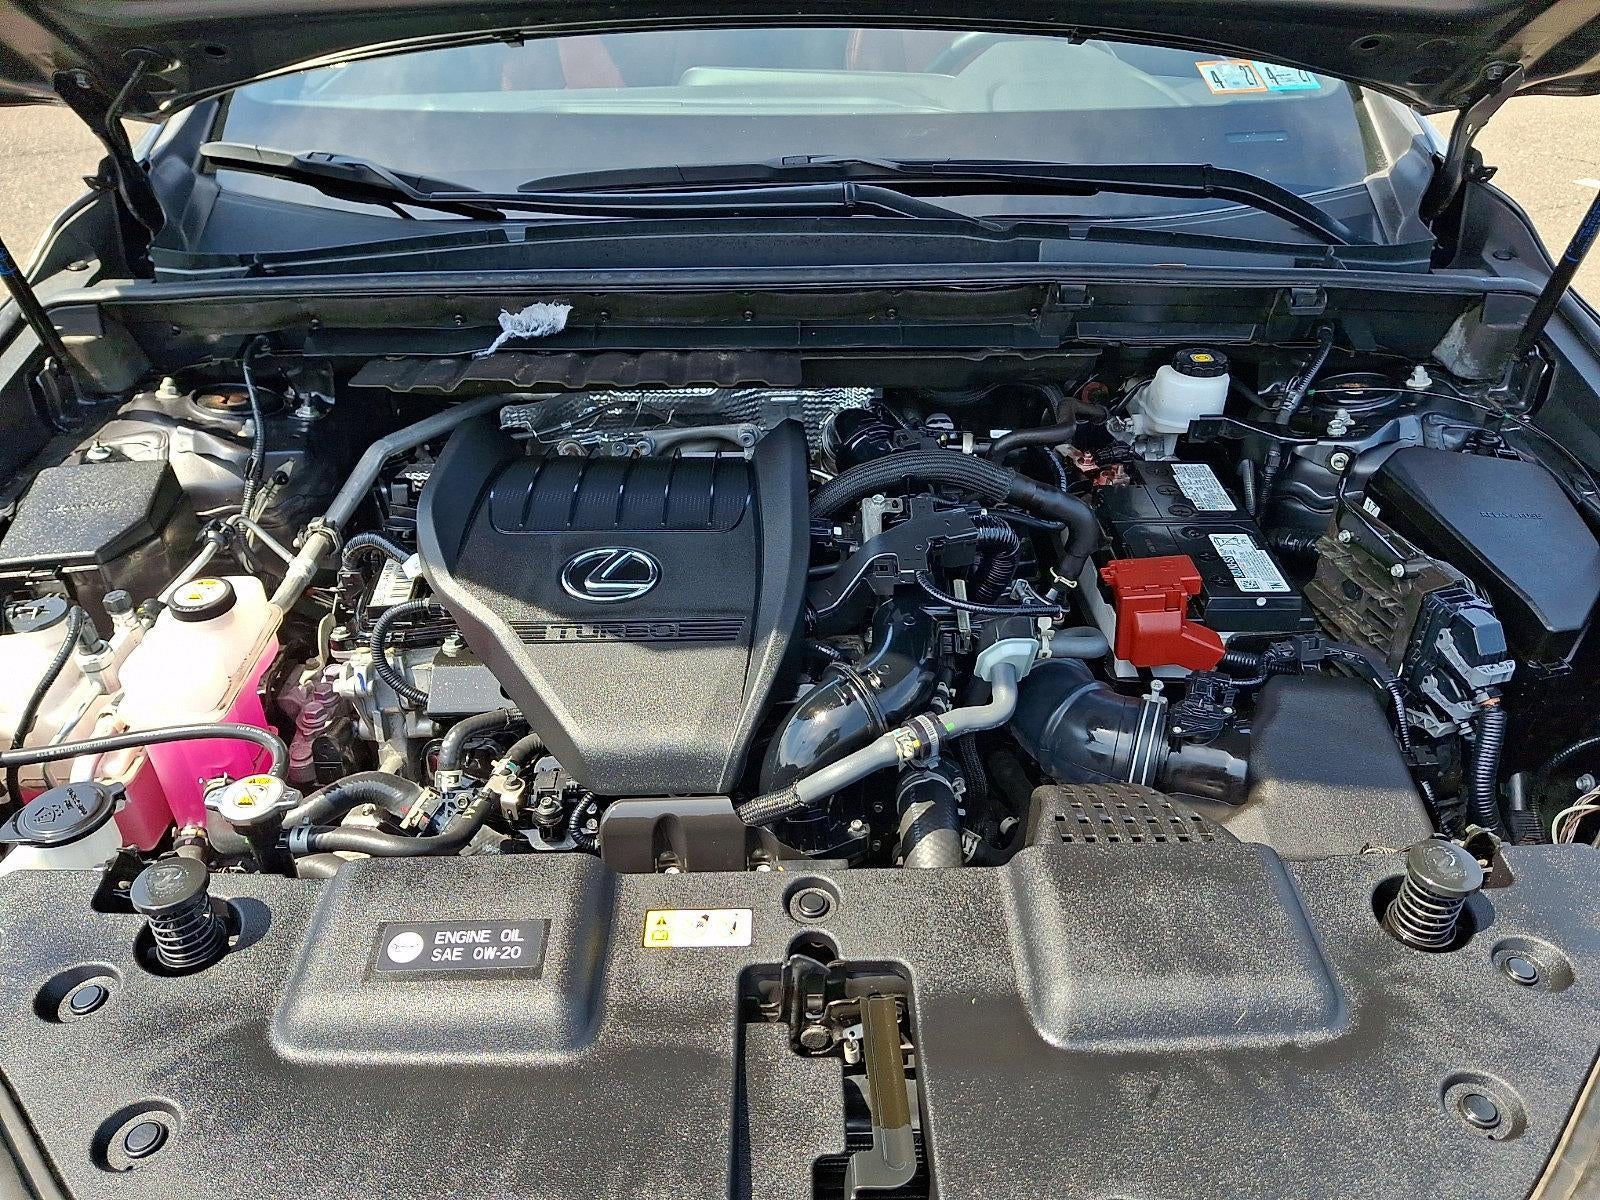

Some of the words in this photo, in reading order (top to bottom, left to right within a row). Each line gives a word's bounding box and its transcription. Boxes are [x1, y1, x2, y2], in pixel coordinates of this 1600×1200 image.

[434, 929, 492, 944] ENGINE
[500, 928, 525, 942] OIL
[430, 947, 464, 962] SAE
[472, 945, 522, 960] 0W-20
